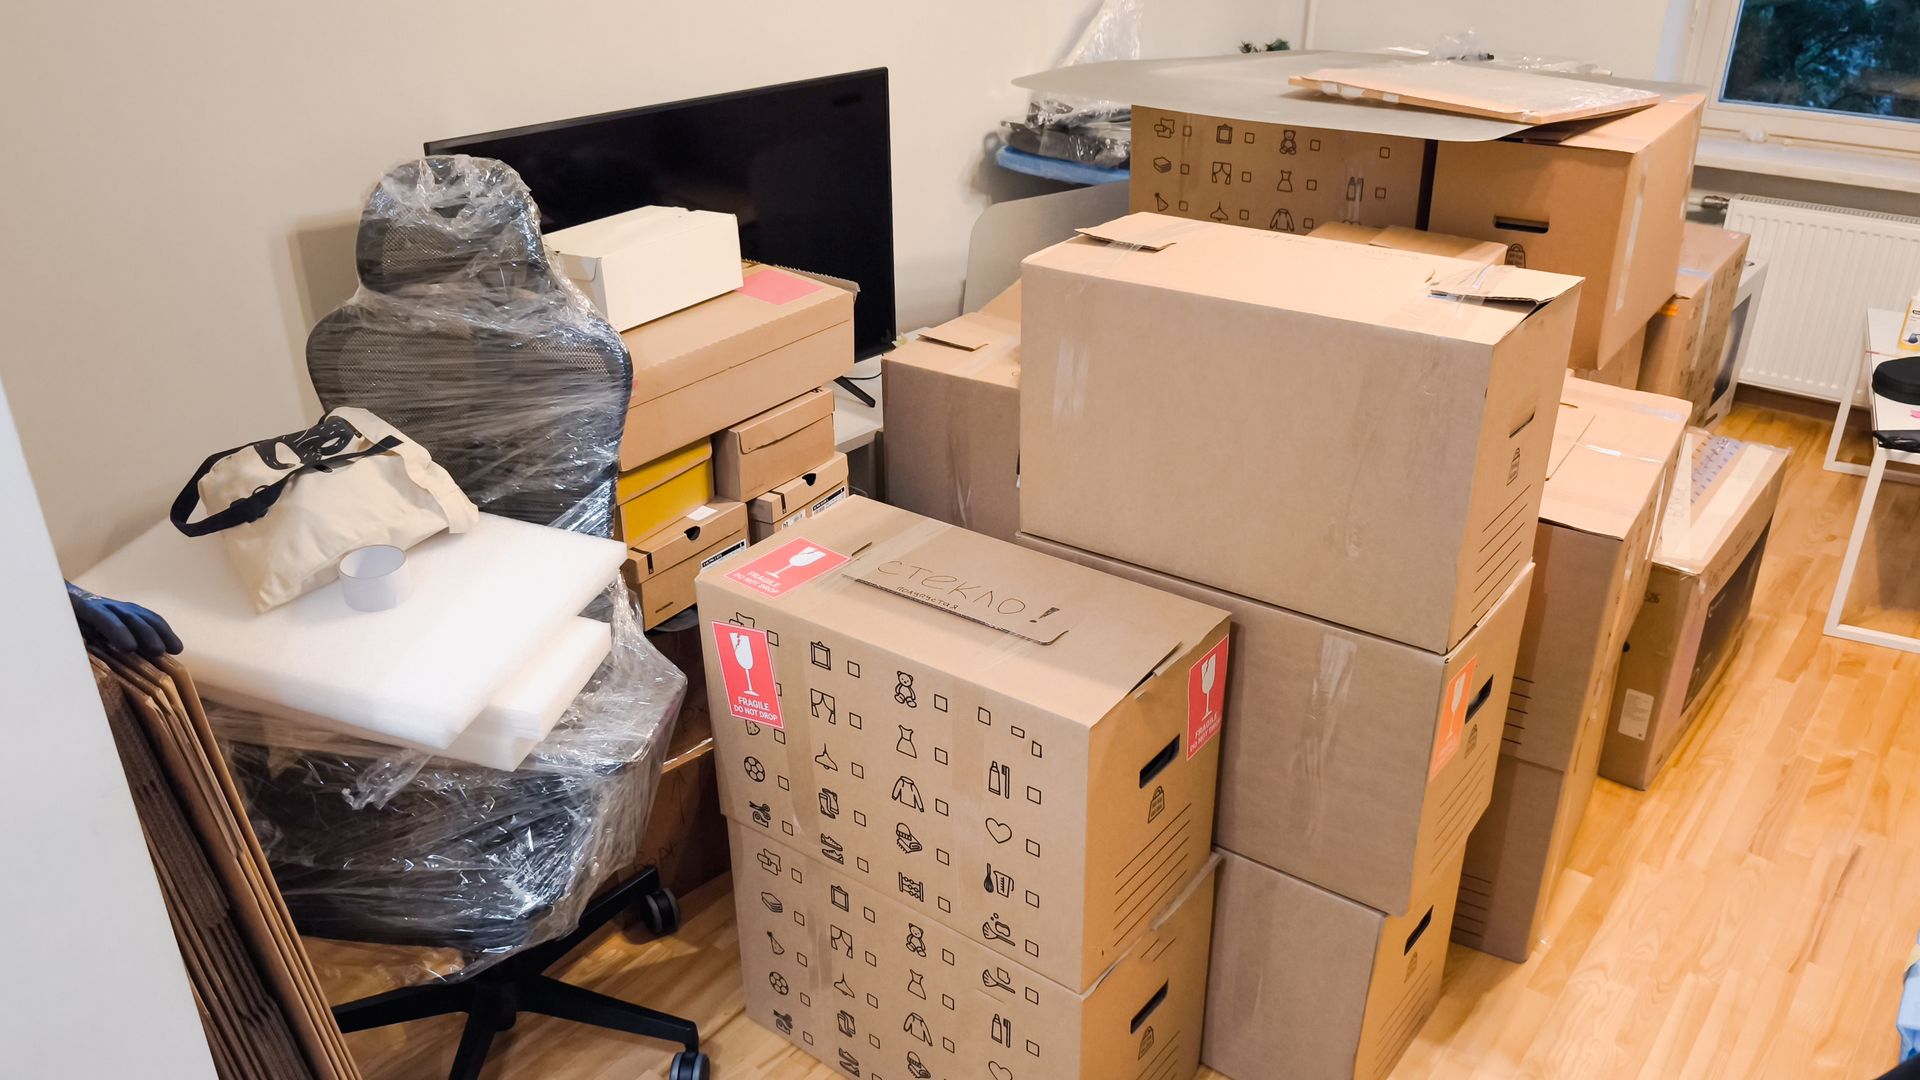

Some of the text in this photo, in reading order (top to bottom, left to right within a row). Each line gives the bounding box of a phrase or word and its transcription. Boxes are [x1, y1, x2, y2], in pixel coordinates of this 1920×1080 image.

[733, 572, 780, 594] DO NOT DROP
[748, 571, 781, 588] FRAGILE
[738, 696, 770, 711] FRAGILE
[733, 704, 778, 722] DO NOT DROP
